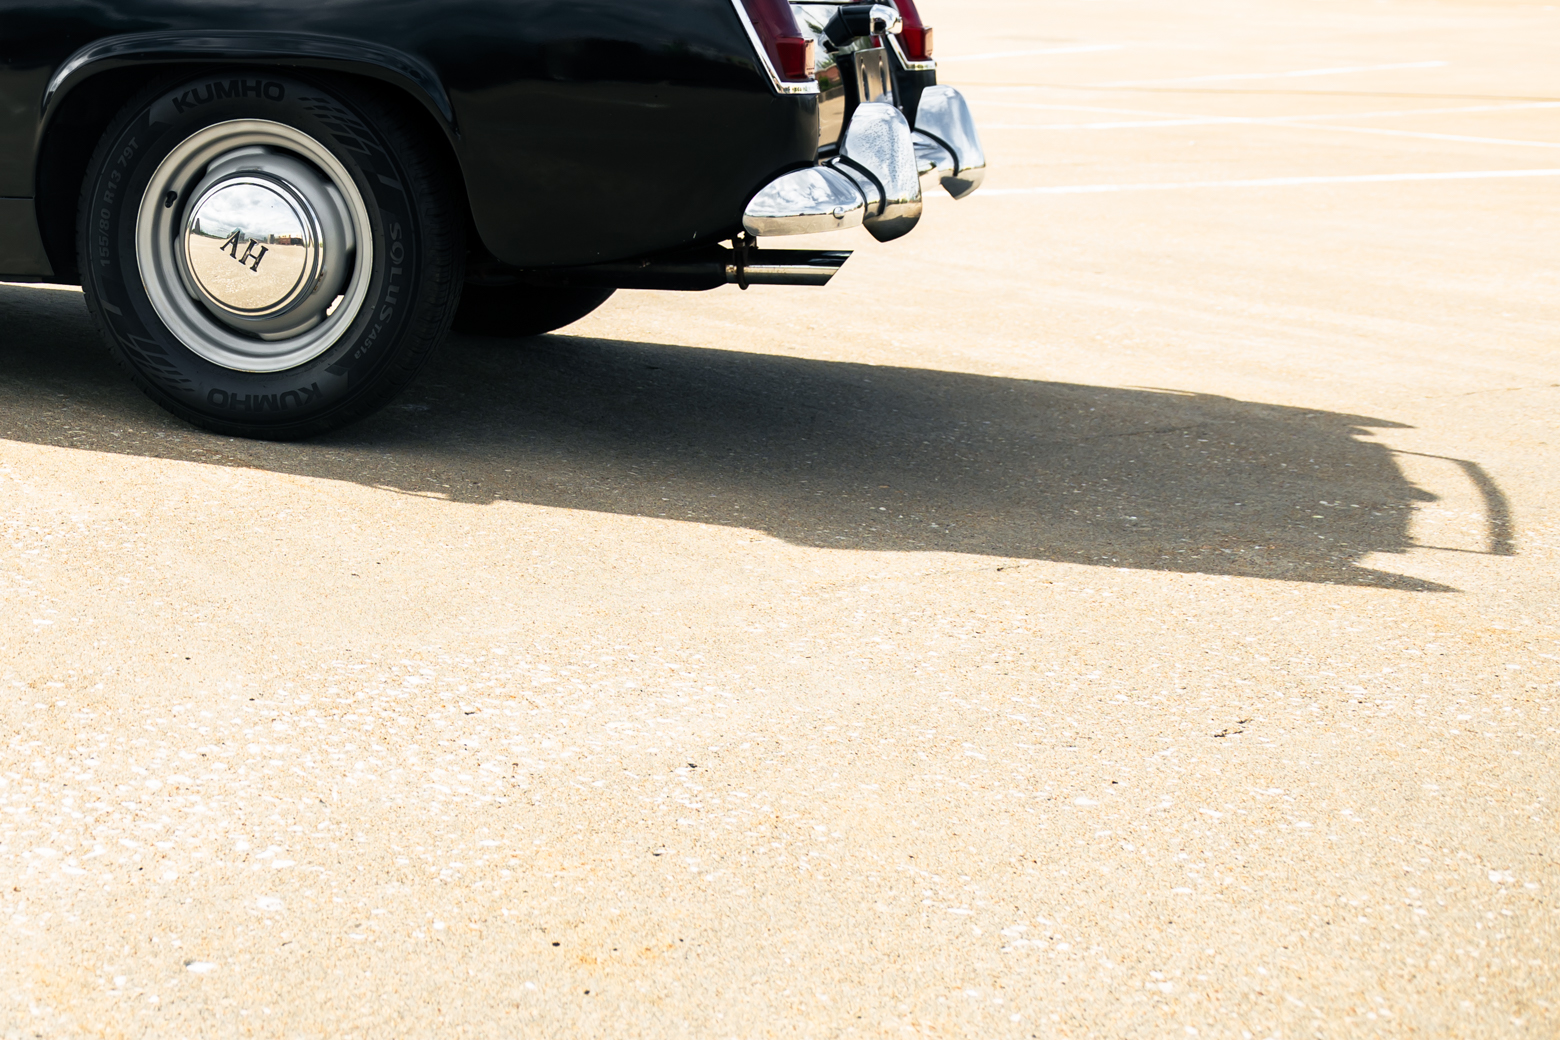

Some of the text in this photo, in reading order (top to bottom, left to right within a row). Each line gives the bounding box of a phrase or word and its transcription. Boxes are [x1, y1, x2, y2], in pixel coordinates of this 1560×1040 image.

[172, 79, 286, 114] KUMHO
[98, 136, 139, 267] 155/80 R13 79T
[220, 230, 269, 272] AH
[354, 222, 405, 360] SOLUS TA51a
[206, 381, 324, 413] KUMHO
